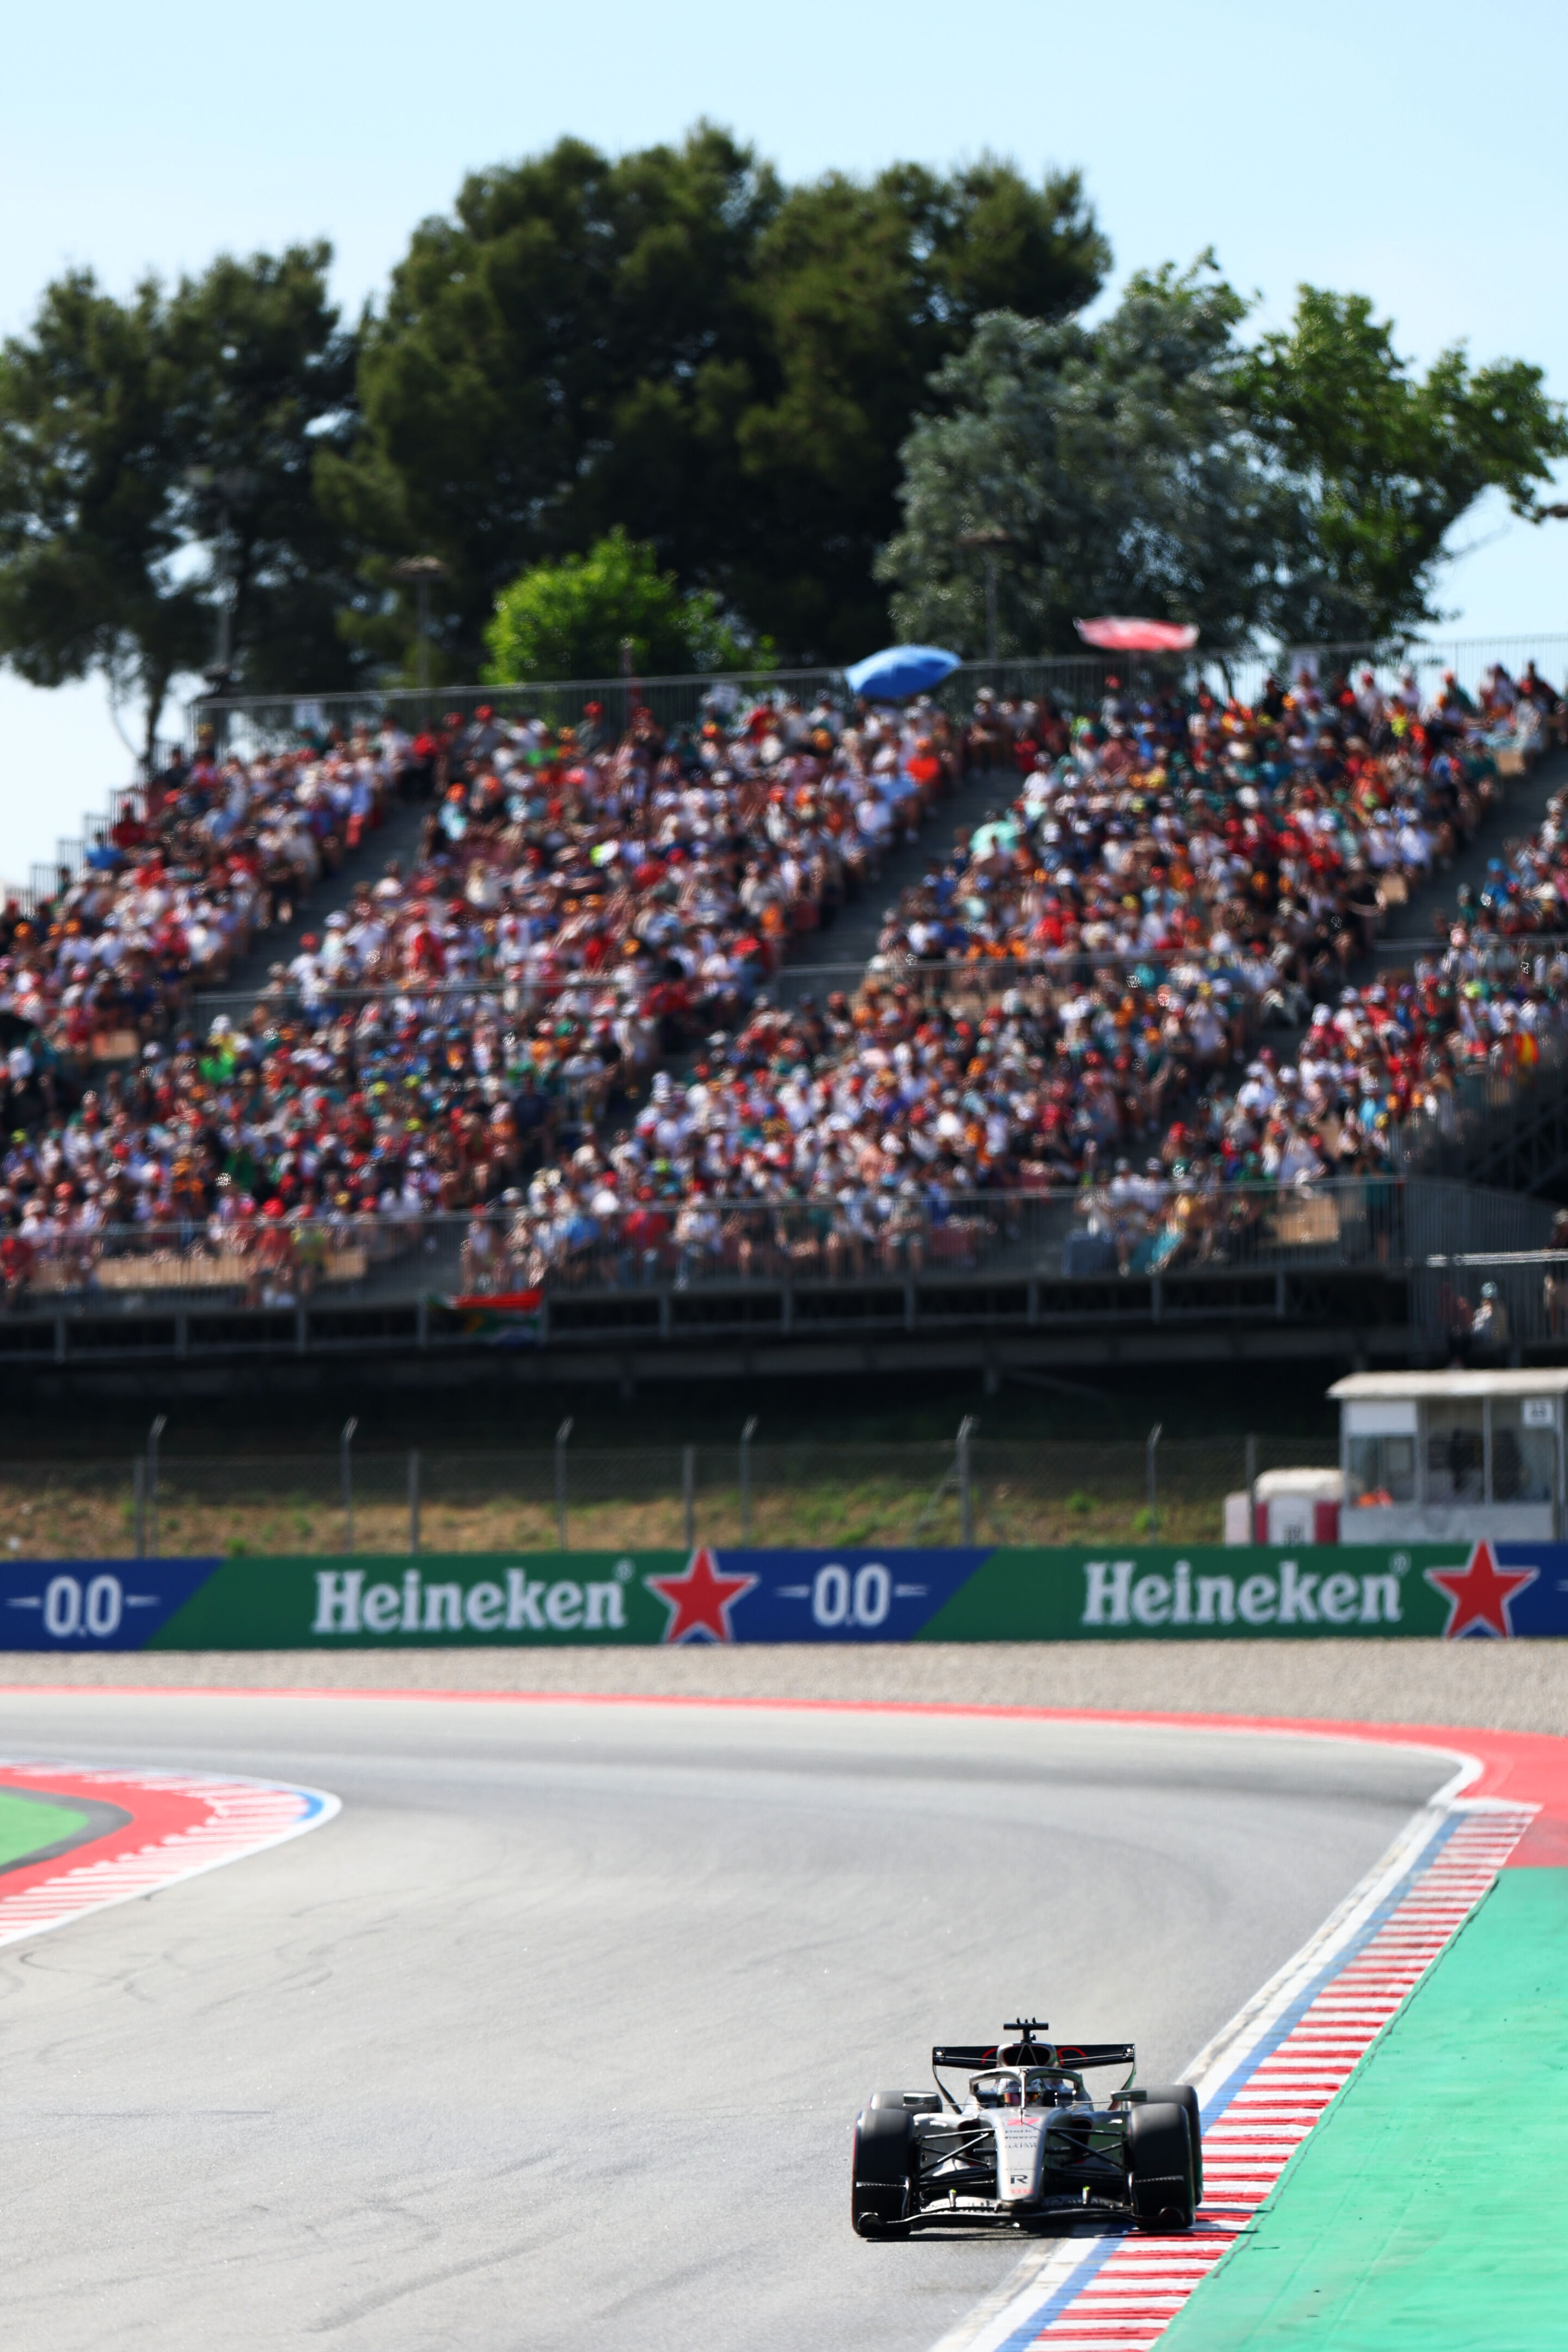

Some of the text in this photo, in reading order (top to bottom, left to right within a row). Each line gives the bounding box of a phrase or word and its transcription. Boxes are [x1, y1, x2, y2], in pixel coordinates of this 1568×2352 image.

[312, 1568, 627, 1632] Heineken
[1081, 1560, 1403, 1625] Heineken
[1010, 2175, 1028, 2184] R
